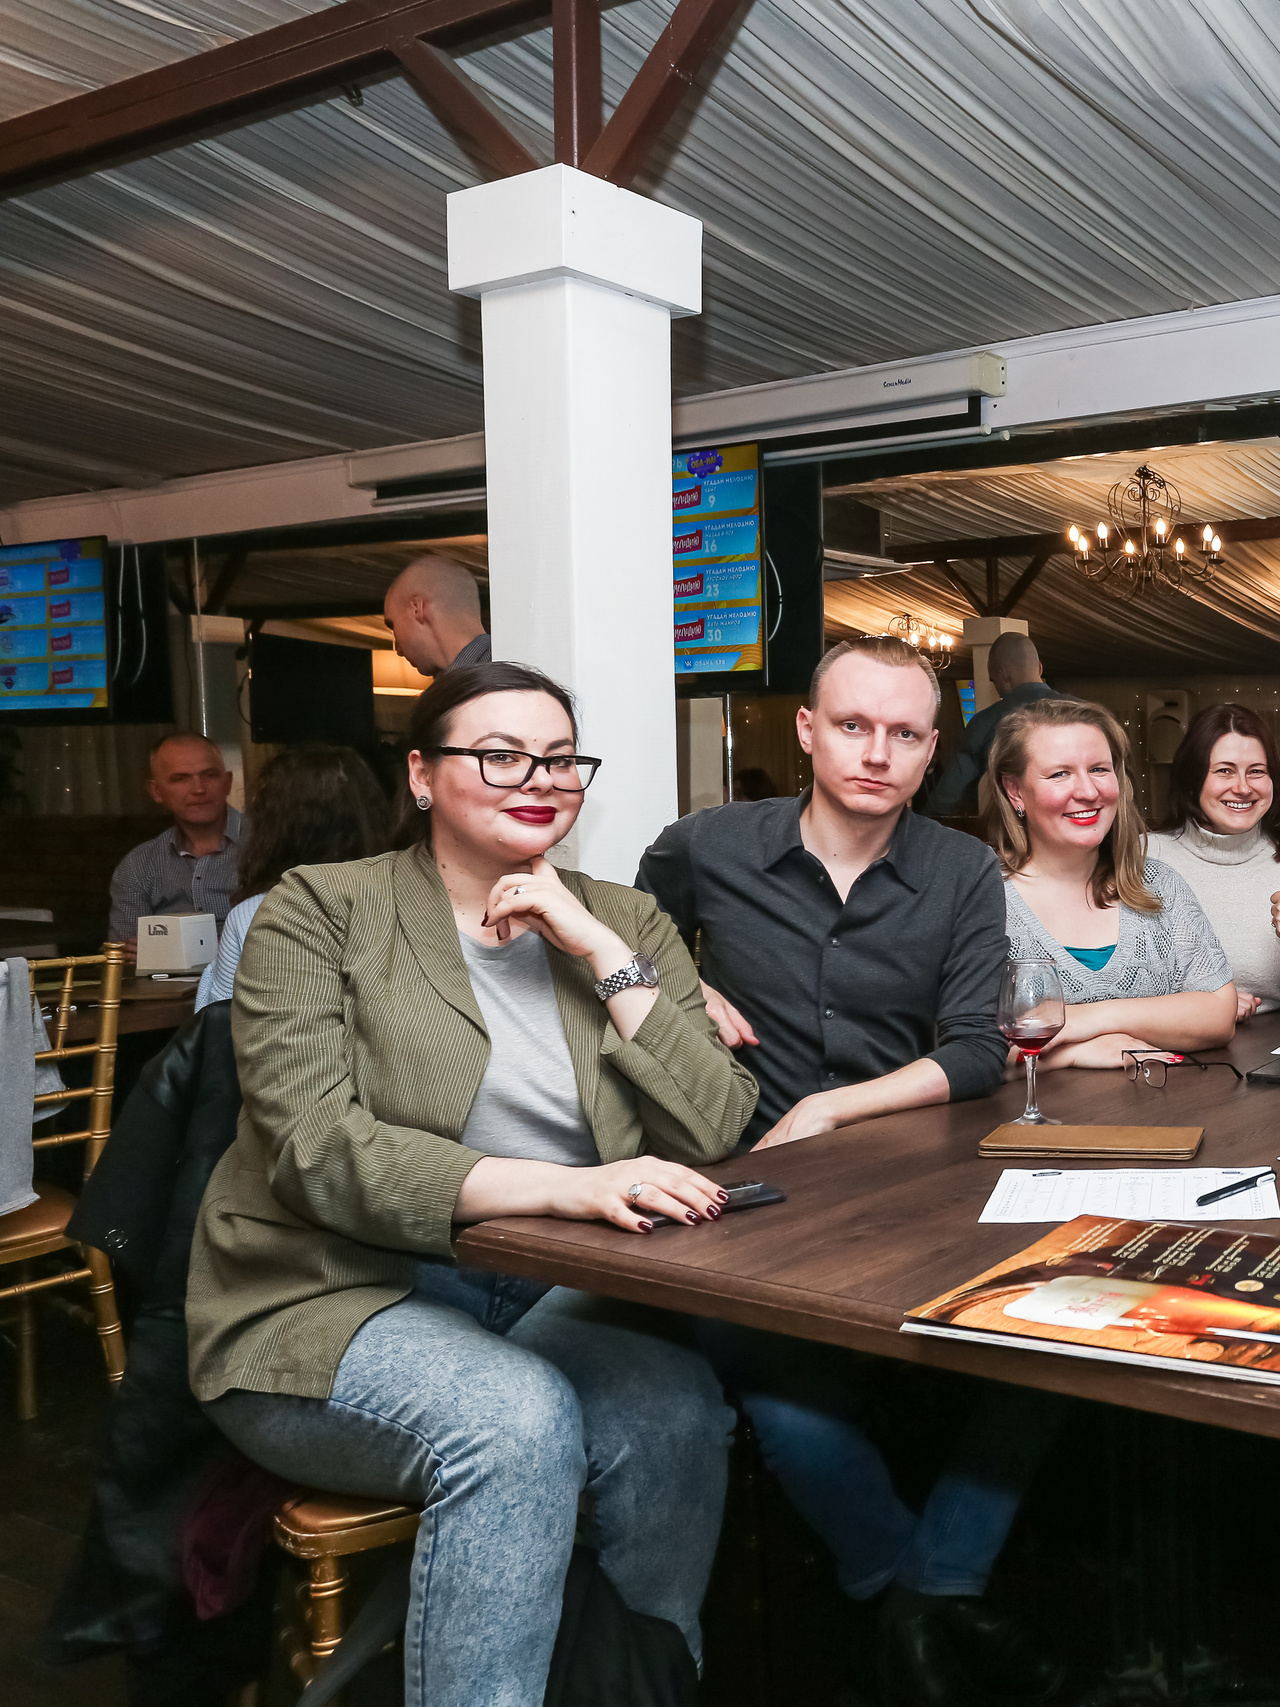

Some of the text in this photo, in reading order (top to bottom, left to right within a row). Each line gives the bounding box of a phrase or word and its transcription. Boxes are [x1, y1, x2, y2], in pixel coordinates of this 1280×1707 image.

[709, 495, 716, 508] 9
[705, 540, 717, 553] 16
[706, 584, 720, 597] 23
[707, 629, 722, 642] 30
[148, 924, 169, 936] Lime
